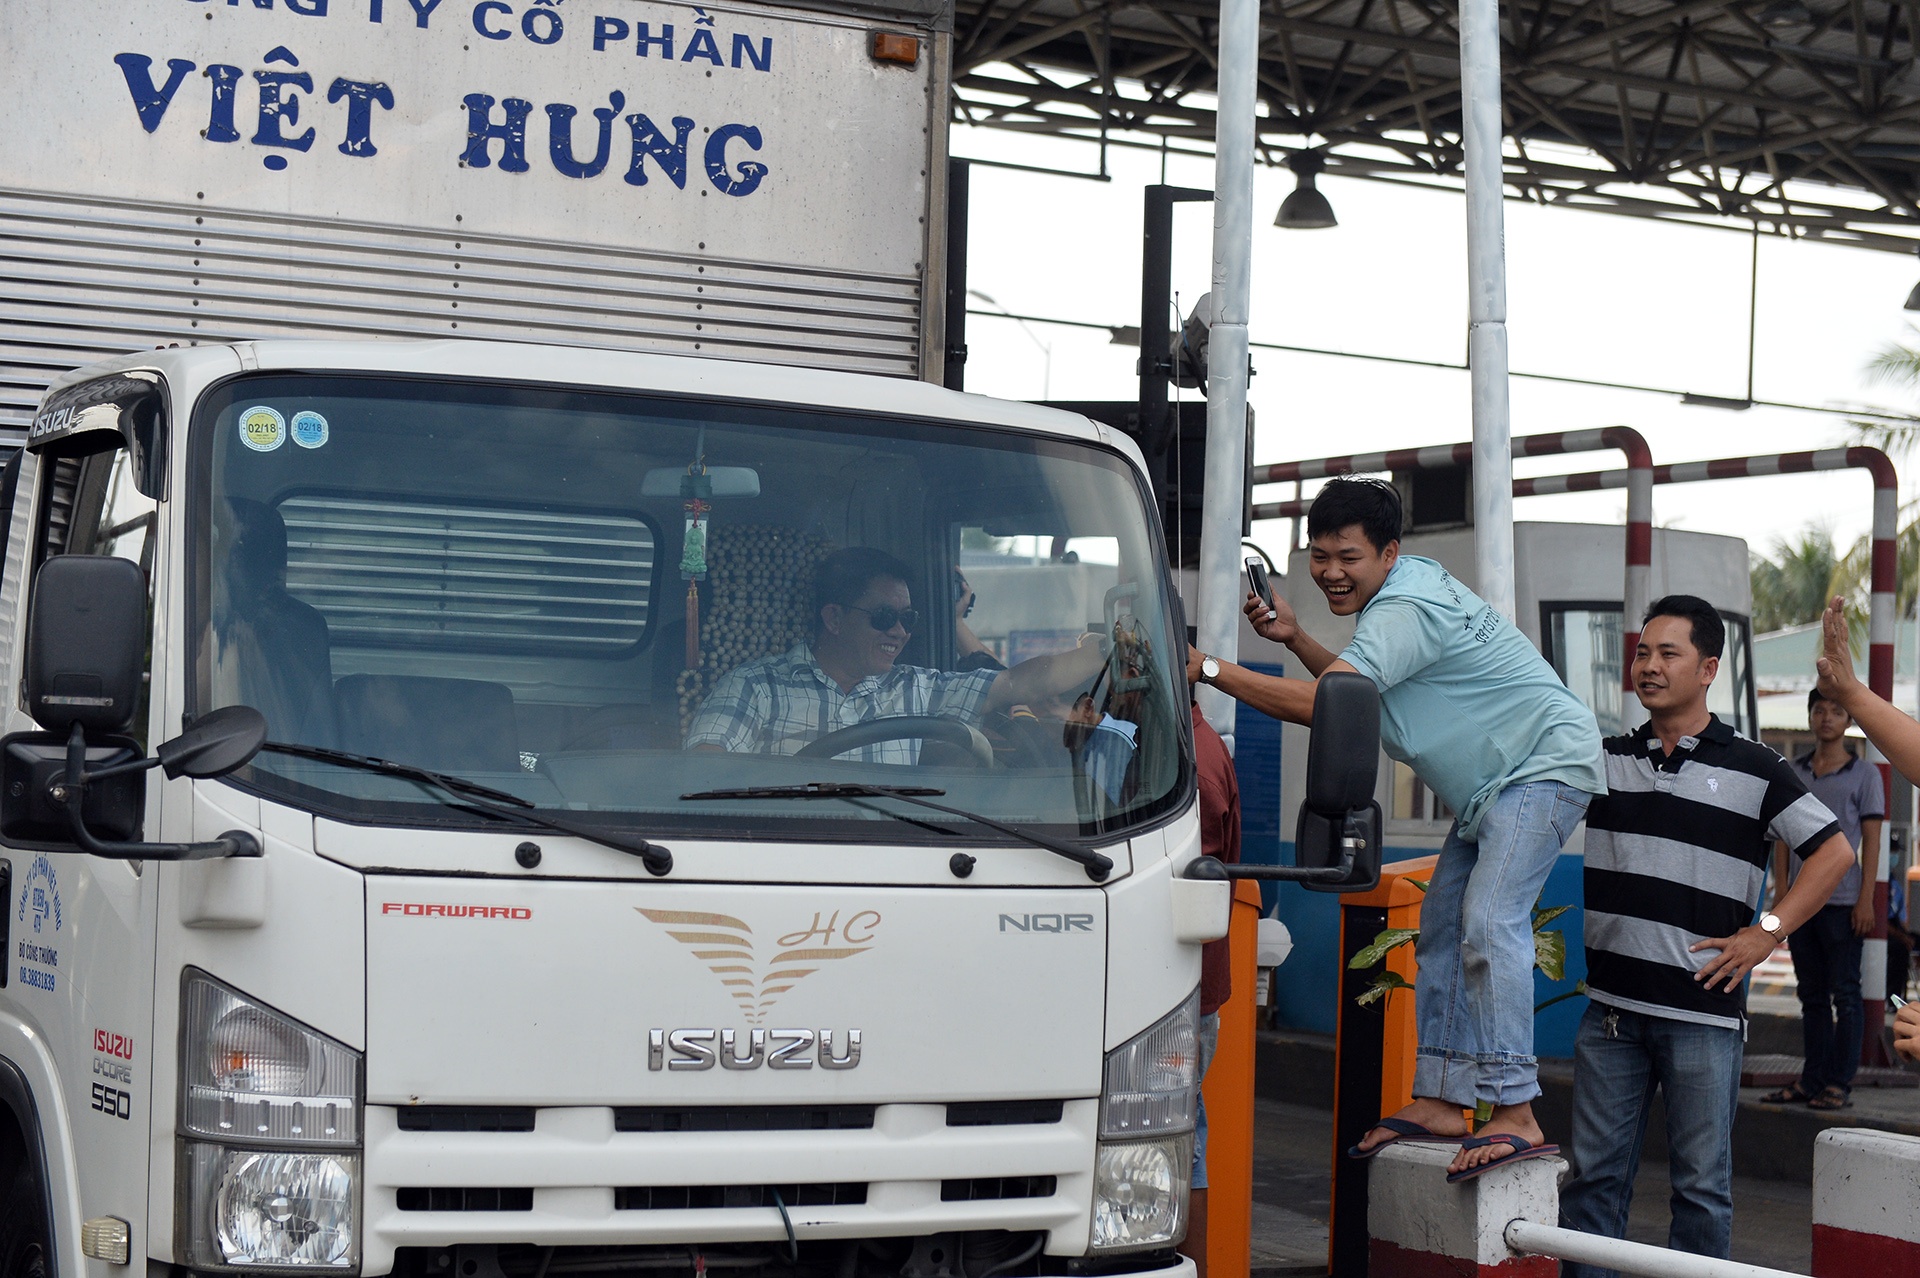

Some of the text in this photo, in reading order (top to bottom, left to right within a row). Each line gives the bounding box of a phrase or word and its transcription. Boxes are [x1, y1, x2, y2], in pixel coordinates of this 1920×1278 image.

[473, 0, 563, 45] CỔ
[594, 8, 773, 73] PHẦN
[114, 45, 769, 197] VIỆT HƯNG
[33, 405, 76, 438] ISUZU
[248, 423, 277, 433] 02/18
[298, 422, 323, 432] 02/18
[382, 903, 531, 920] FORWARD
[999, 913, 1094, 933] NQR
[94, 1028, 133, 1060] ISUZU
[647, 1028, 862, 1071] ISUZU
[93, 1057, 132, 1084] D-CORE
[92, 1081, 131, 1121] 550
